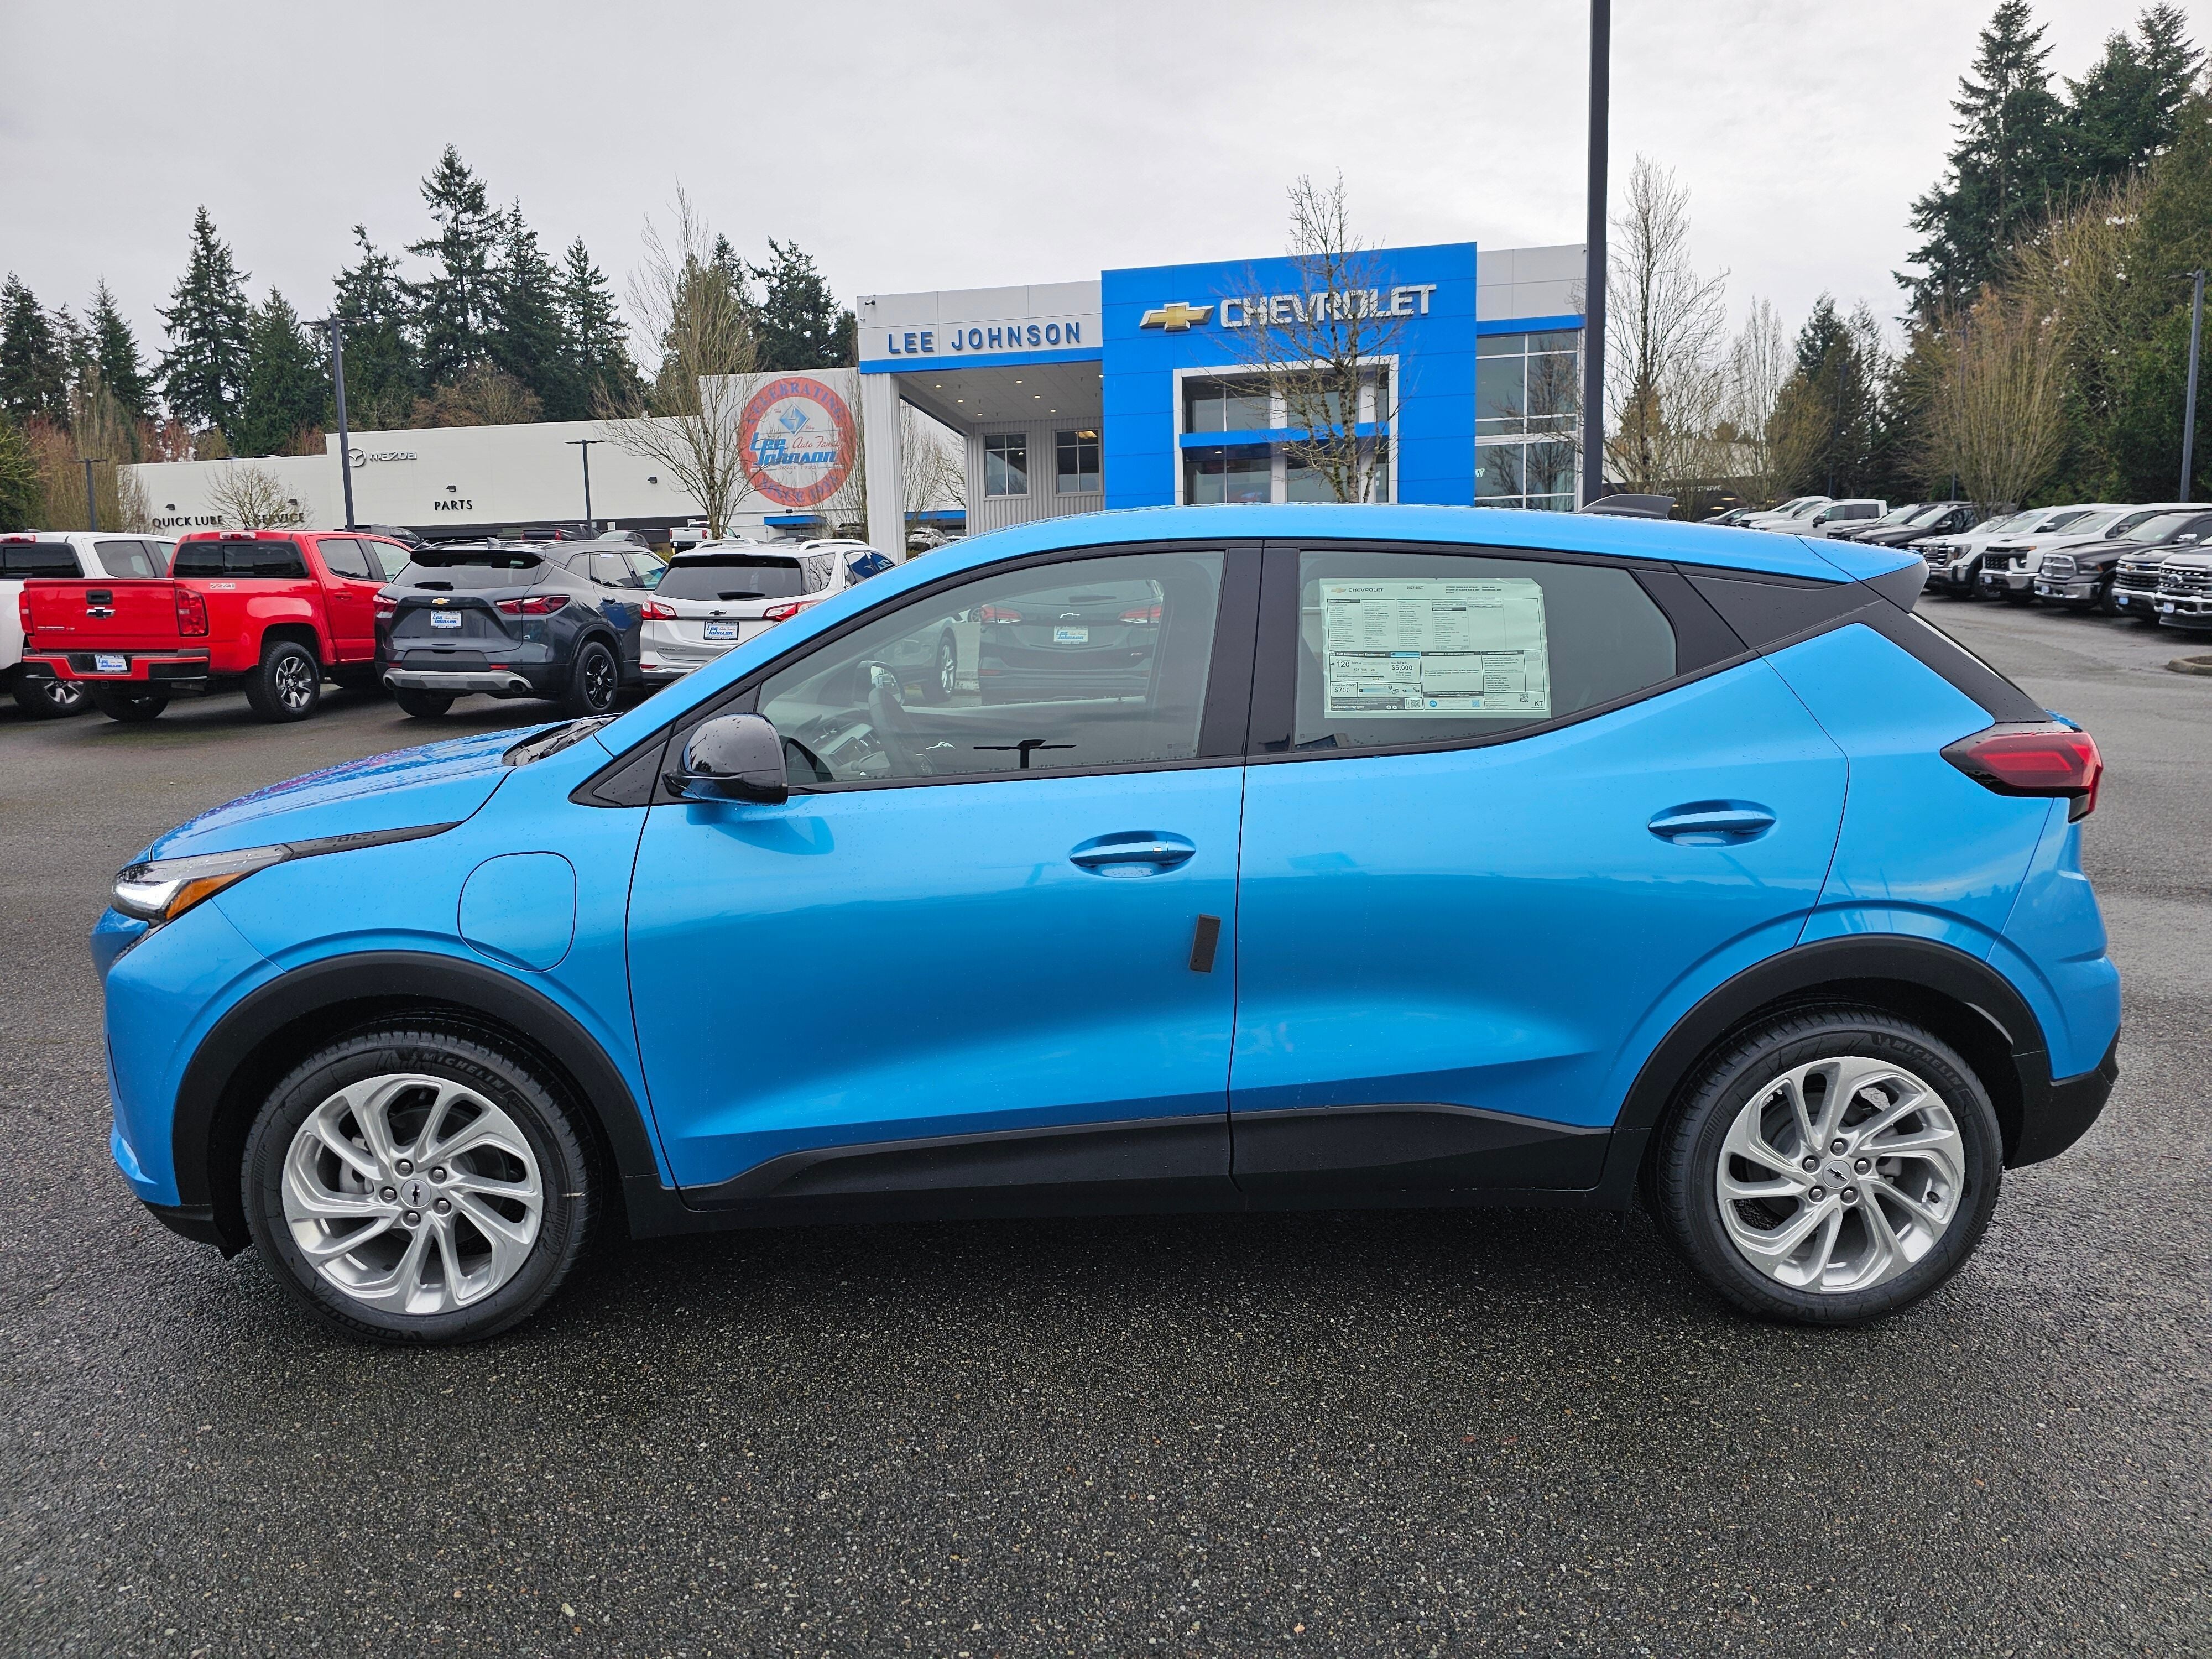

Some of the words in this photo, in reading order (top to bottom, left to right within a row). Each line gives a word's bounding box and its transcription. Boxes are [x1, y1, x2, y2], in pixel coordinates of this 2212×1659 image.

[1220, 284, 1437, 328] CHEVROLET
[888, 331, 934, 354] LEE
[951, 322, 1080, 351] JOHNSON
[750, 432, 787, 451] Lee
[792, 436, 813, 449] Auto
[815, 436, 842, 451] Family
[756, 442, 836, 465] Johnson
[434, 499, 473, 510] PARTS
[152, 517, 192, 528] QUICK
[195, 515, 223, 525] LUBE
[422, 1052, 505, 1090] MICHELIN
[1892, 1040, 1962, 1086] MICHELIN
